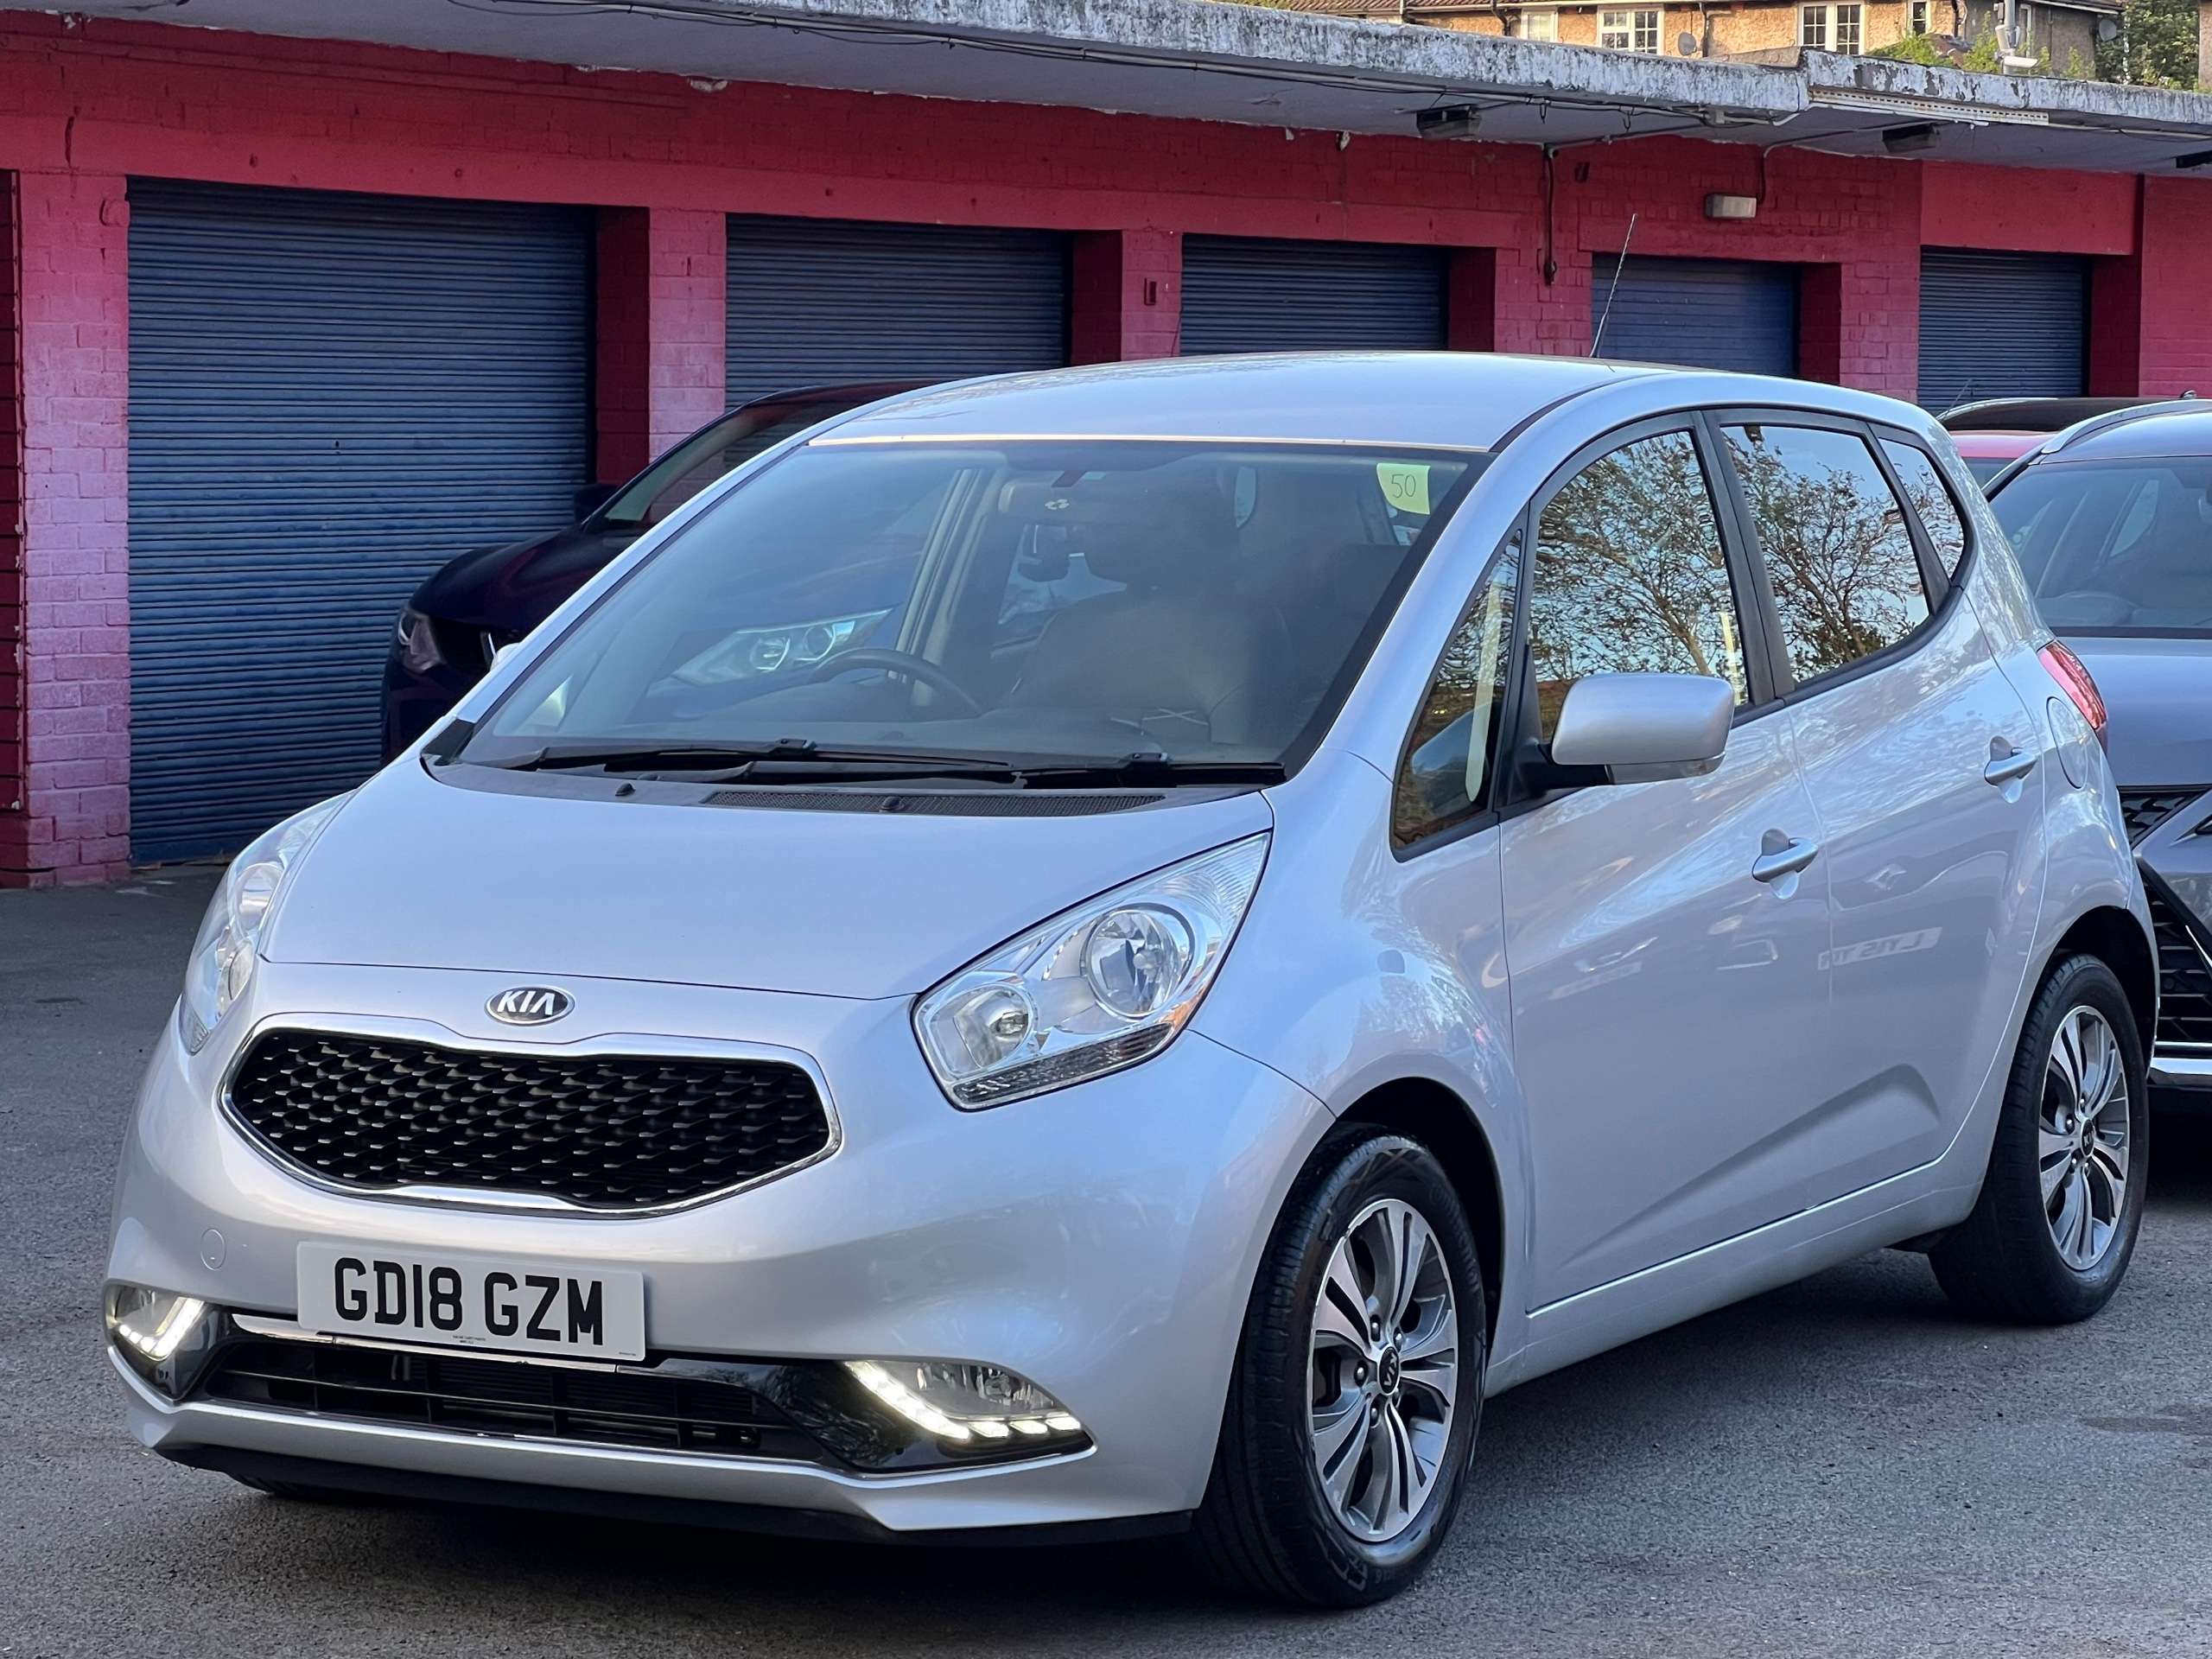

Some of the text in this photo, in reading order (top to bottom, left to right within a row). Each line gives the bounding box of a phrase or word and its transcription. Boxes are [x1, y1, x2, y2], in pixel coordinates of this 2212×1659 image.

[1391, 474, 1417, 499] 50
[497, 989, 556, 1016] KIA
[334, 1257, 604, 1346] GD18 GZM
[1383, 1351, 1398, 1386] KIA
